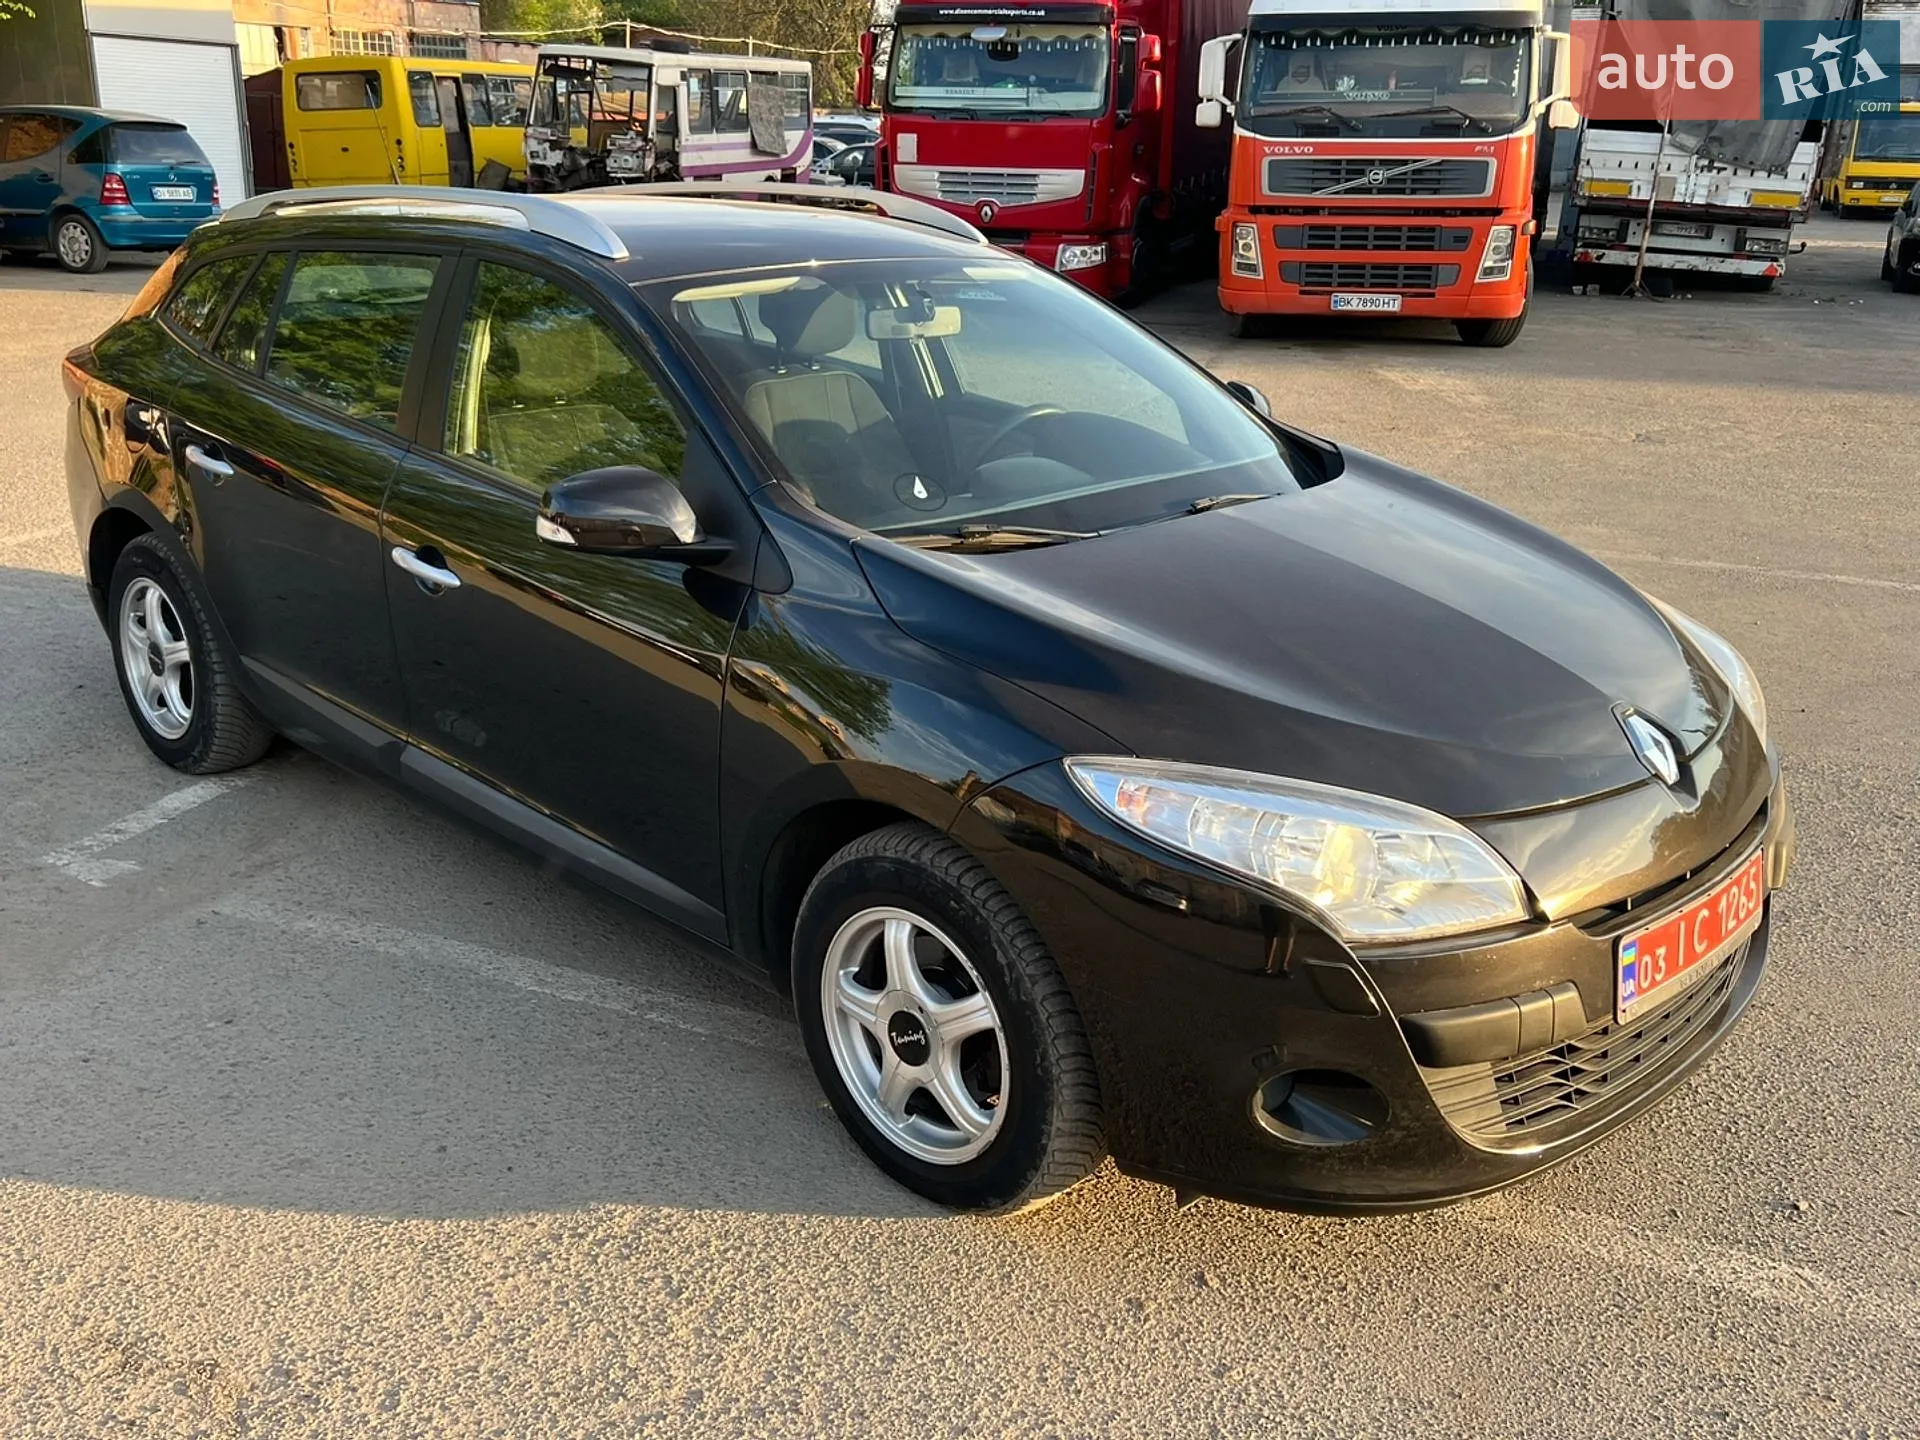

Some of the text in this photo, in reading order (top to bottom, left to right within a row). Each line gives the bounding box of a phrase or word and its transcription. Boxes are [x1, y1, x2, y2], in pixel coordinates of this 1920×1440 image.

[1263, 146, 1314, 154] VOLVO
[1338, 297, 1398, 309] BK 7890 HT
[1640, 945, 1667, 989] 03
[1718, 866, 1757, 937] 1265
[890, 1030, 926, 1047] Tuning
